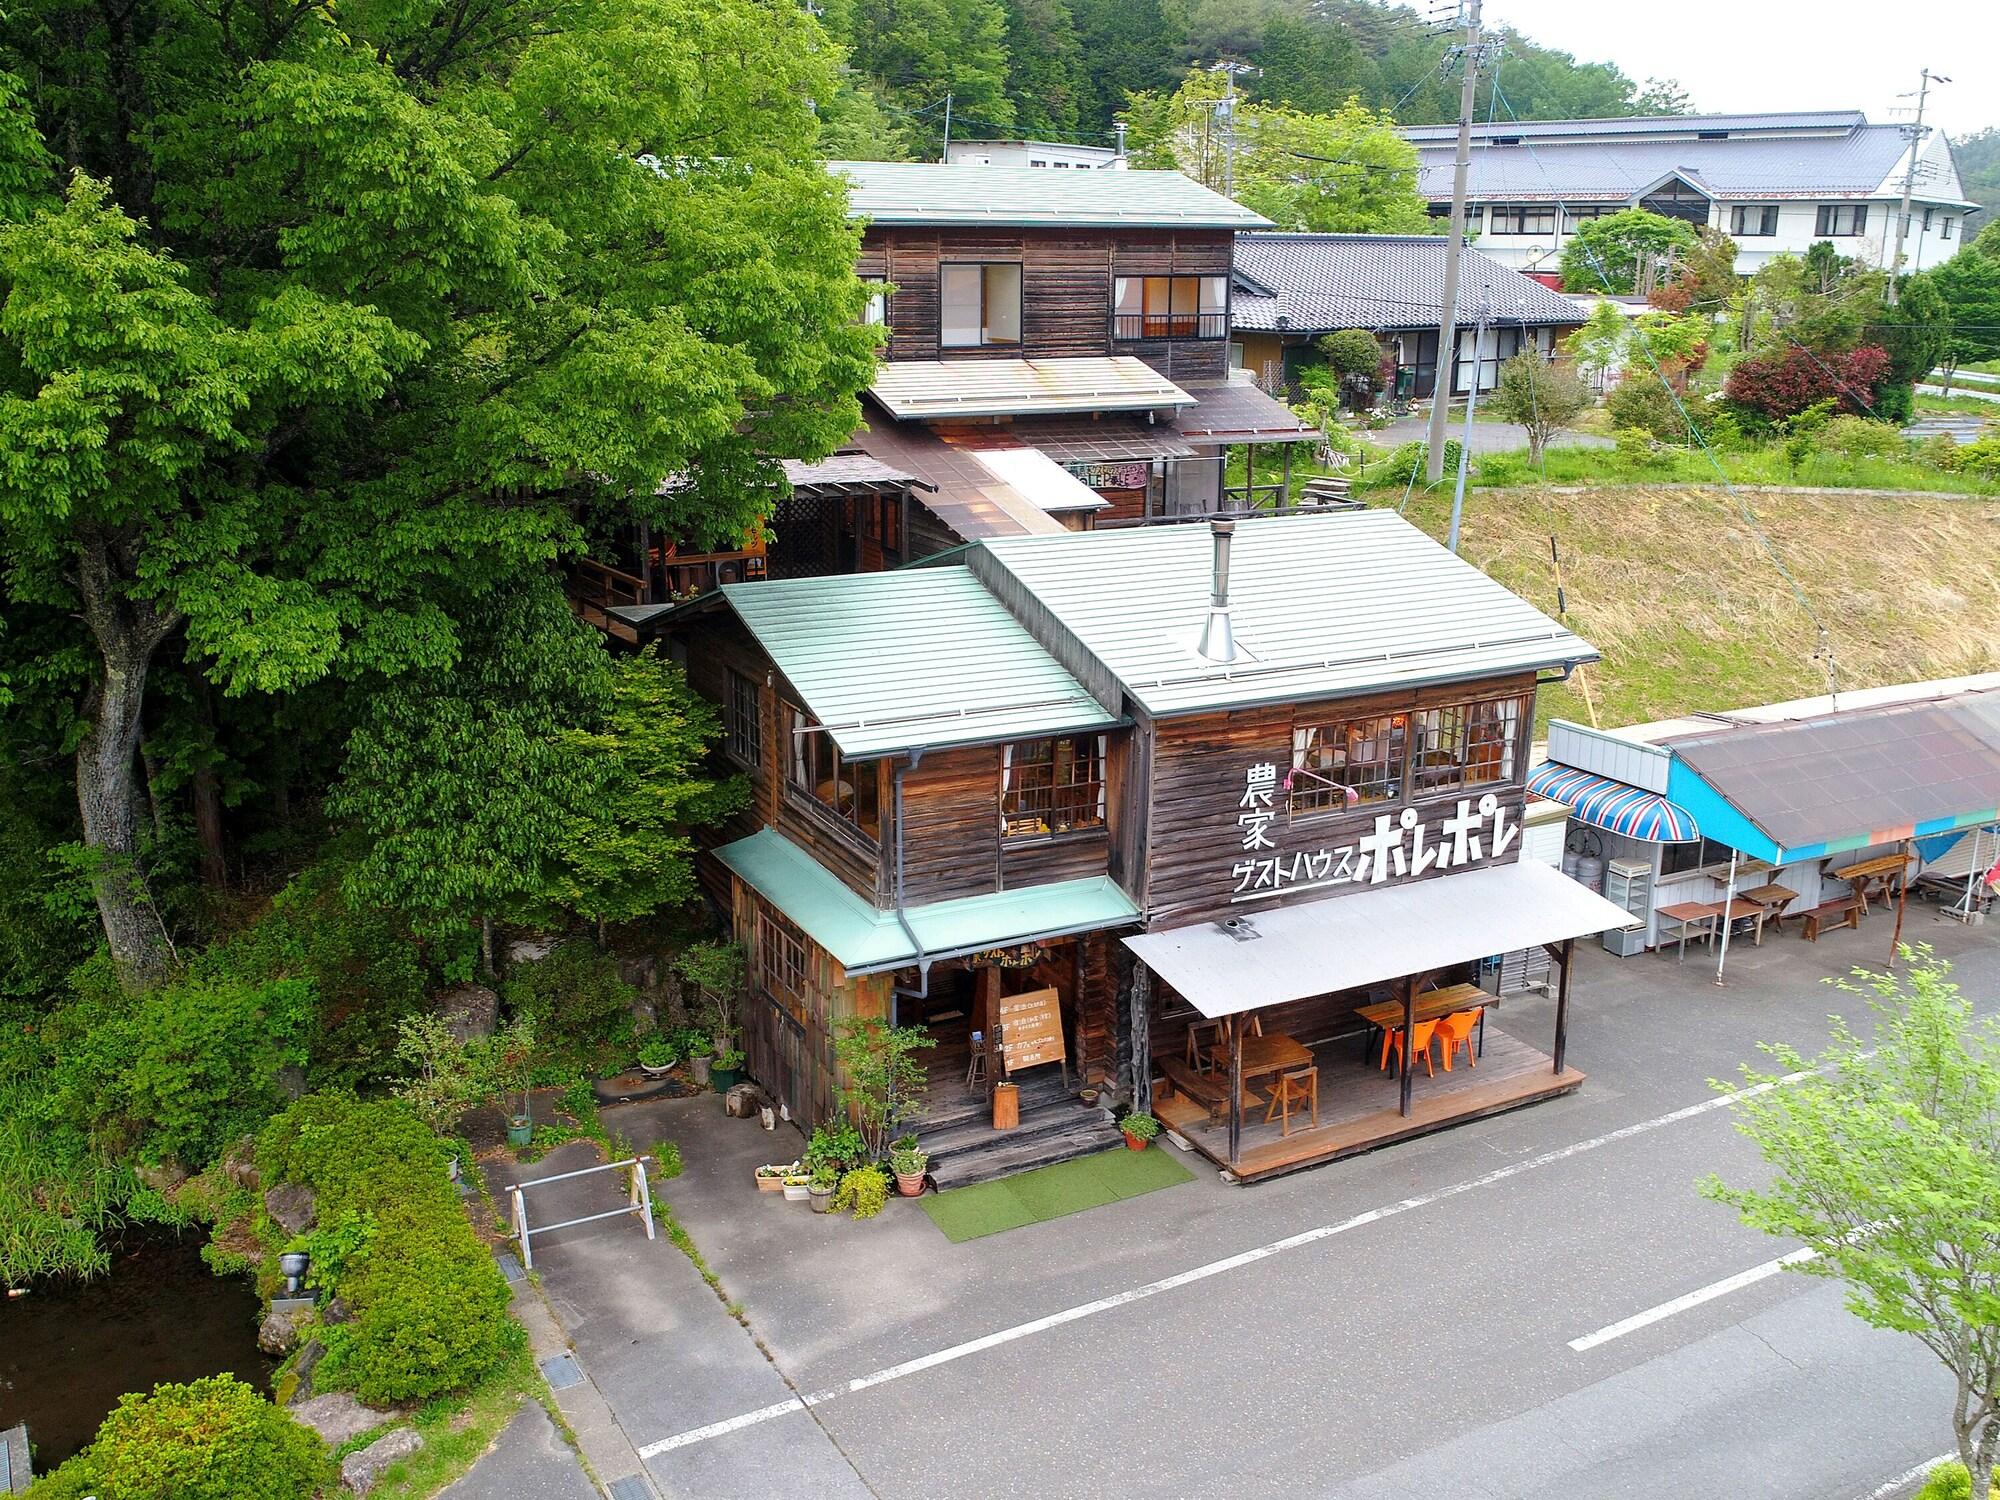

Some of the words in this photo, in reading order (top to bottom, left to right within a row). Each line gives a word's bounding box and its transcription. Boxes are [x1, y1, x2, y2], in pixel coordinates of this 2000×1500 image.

[1231, 846, 1355, 893] ゲストハウス
[1352, 793, 1519, 885] ポレポレ
[1238, 762, 1277, 851] 農家
